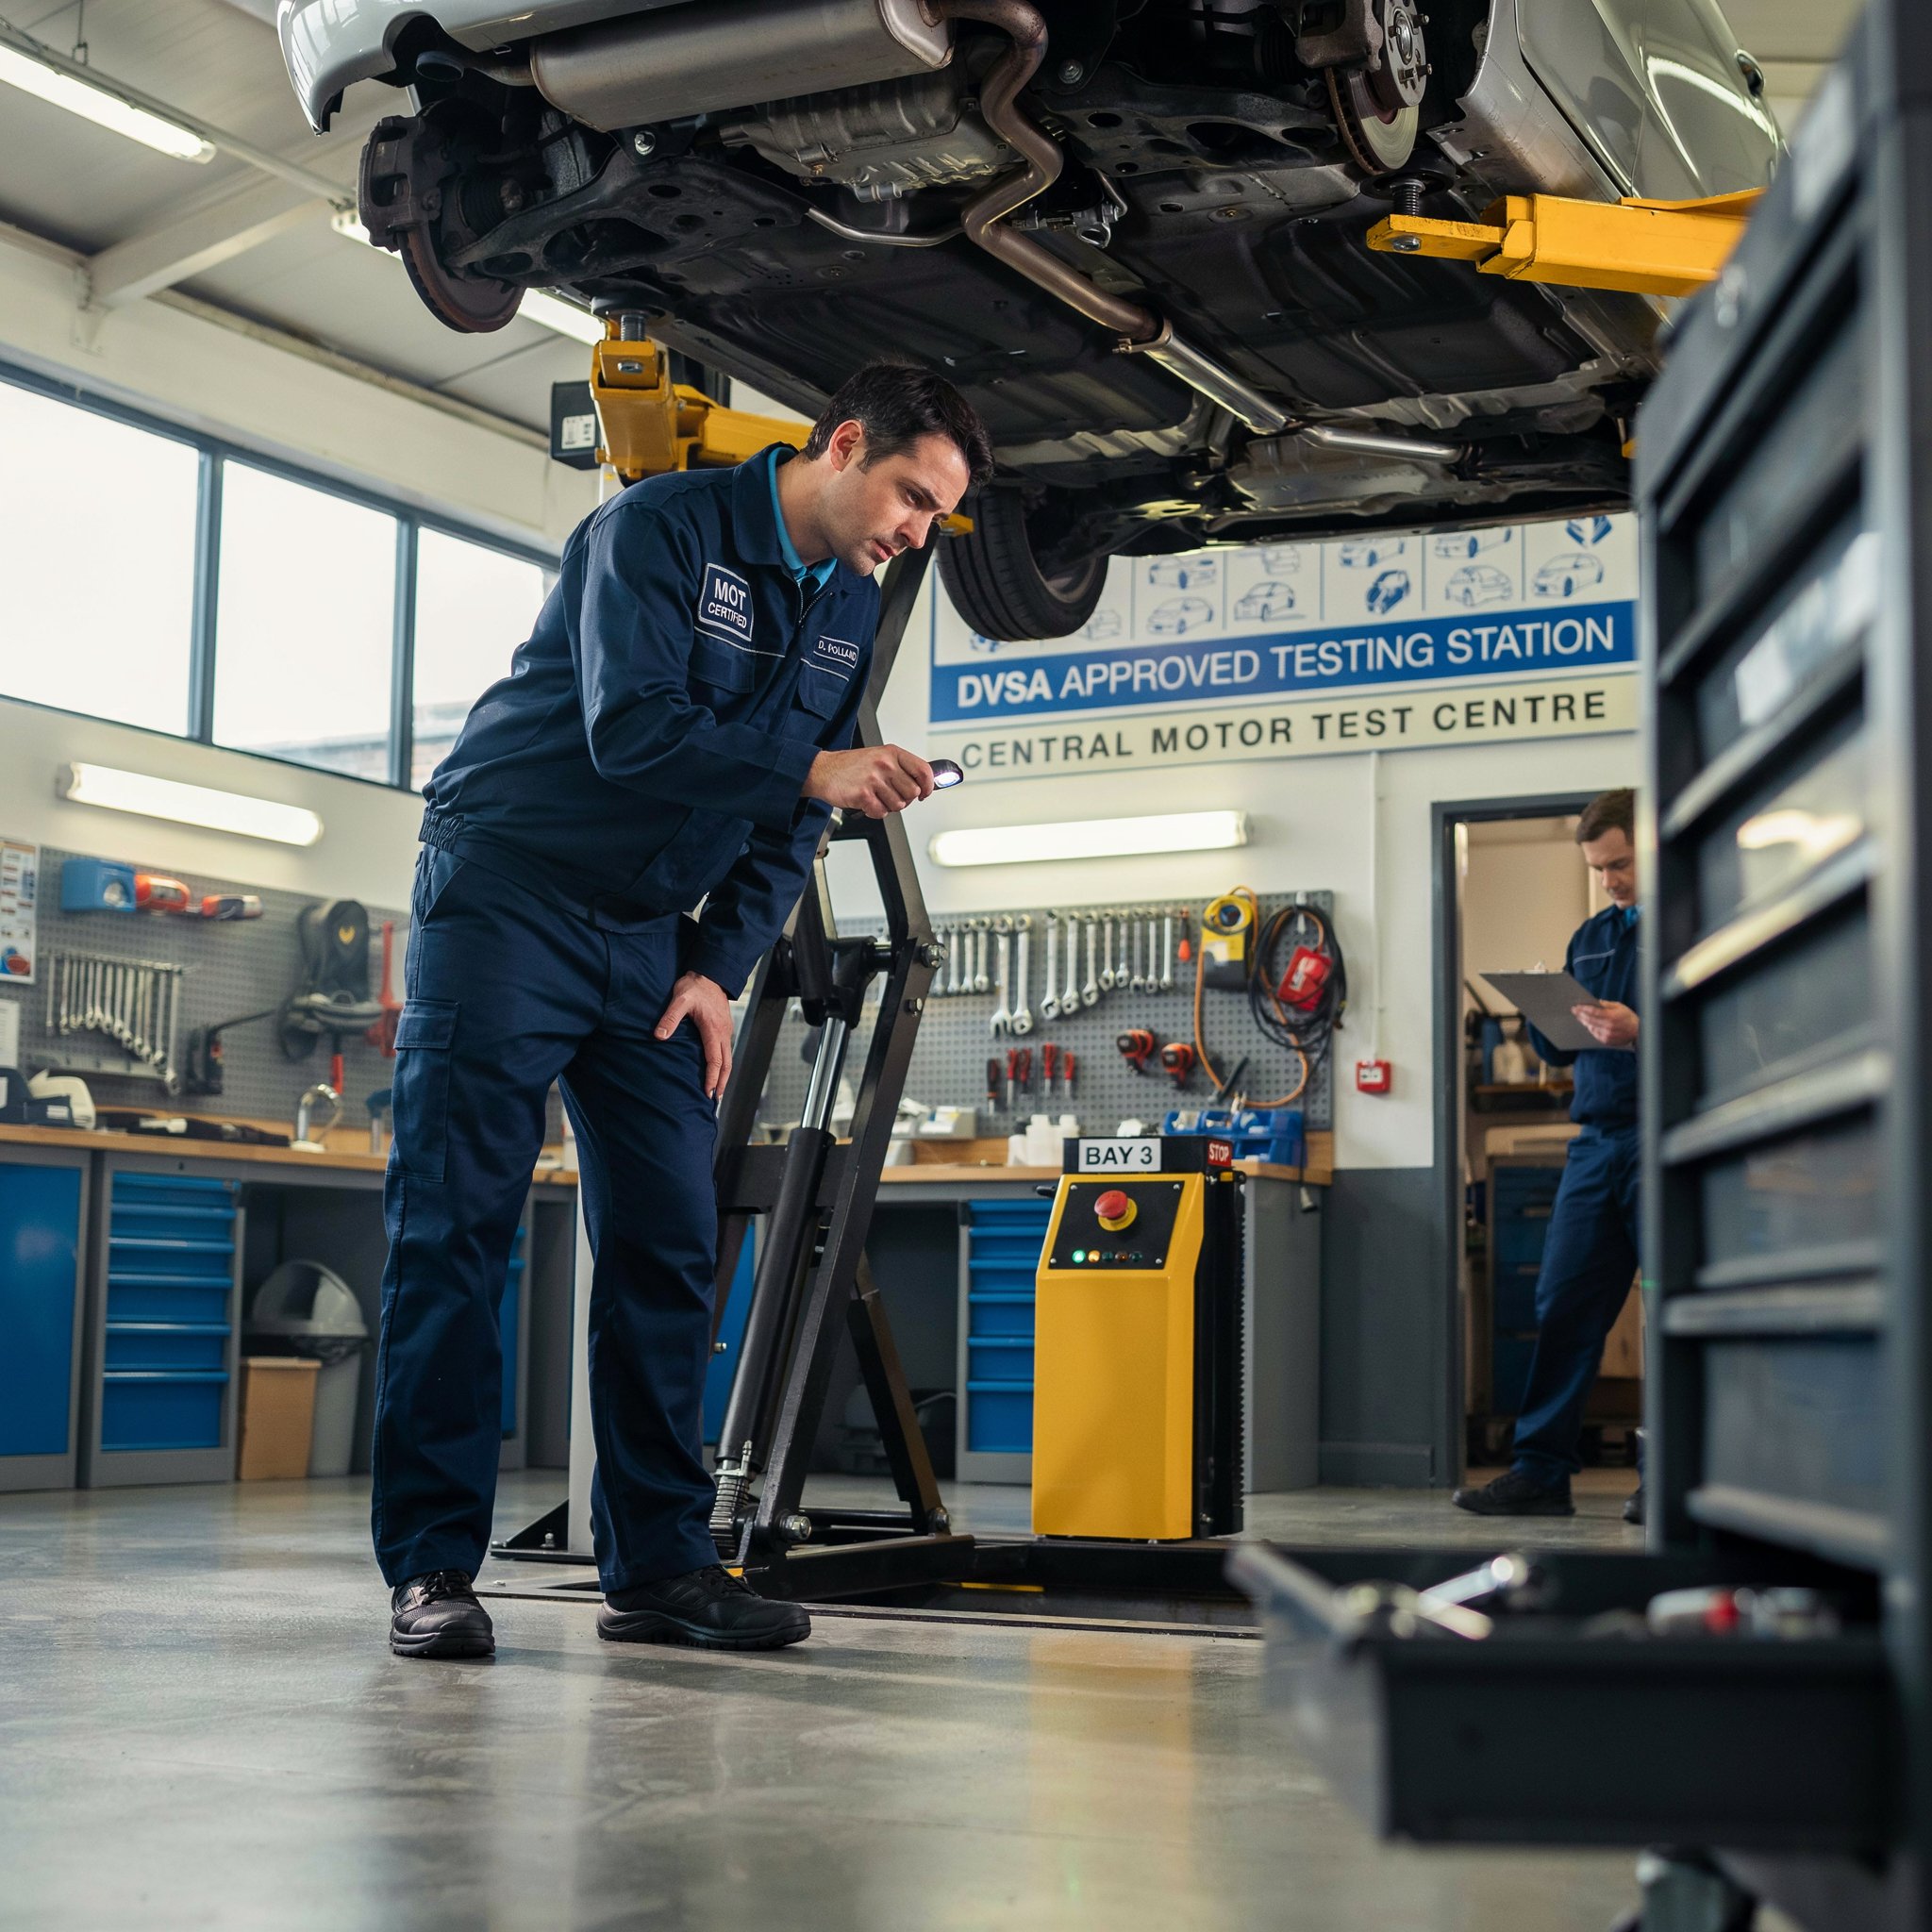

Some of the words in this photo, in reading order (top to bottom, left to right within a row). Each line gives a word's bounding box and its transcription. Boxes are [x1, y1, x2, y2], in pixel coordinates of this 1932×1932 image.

[714, 577, 746, 610] MOT
[818, 640, 826, 651] D.
[958, 667, 1054, 708] DVSA
[1059, 649, 1260, 699] APPROVED
[1269, 632, 1435, 680] TESTING
[1446, 615, 1614, 664] STATION
[961, 730, 1134, 769] CENTRAL
[1152, 717, 1291, 754] MOTOR
[1311, 707, 1412, 741] TEST
[1433, 691, 1606, 731] CENTRE
[1086, 1146, 1133, 1165] BAY
[1140, 1146, 1153, 1165] 3
[1208, 1141, 1230, 1162] STOP
